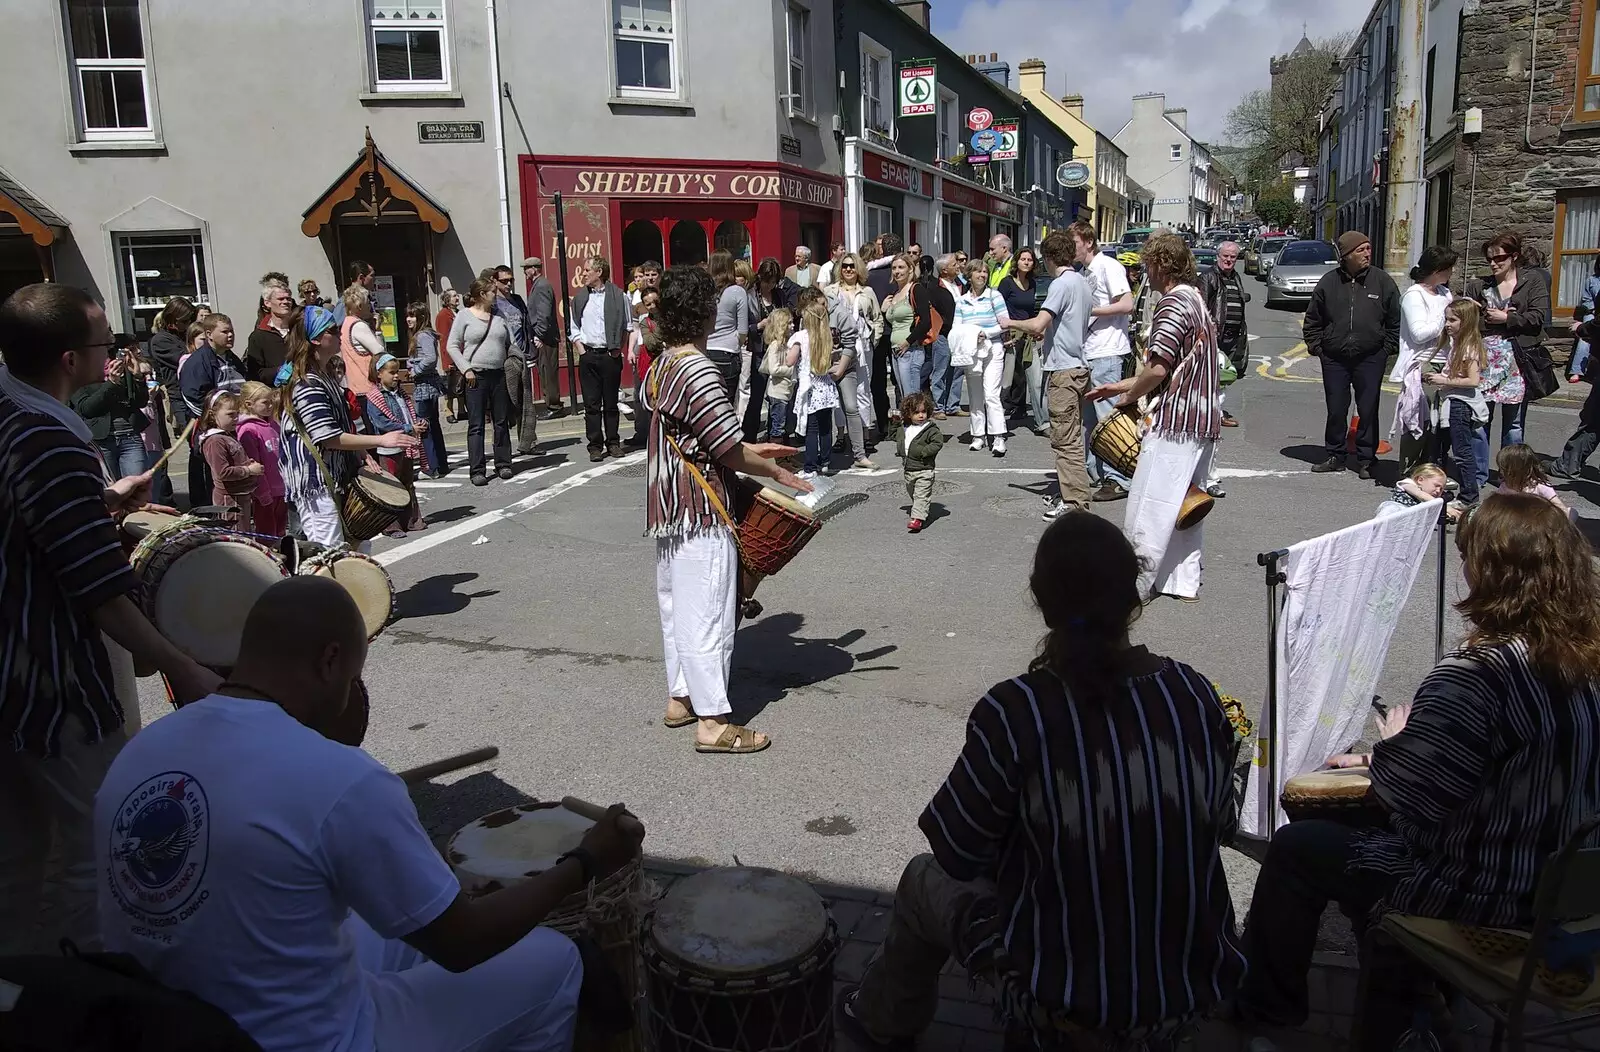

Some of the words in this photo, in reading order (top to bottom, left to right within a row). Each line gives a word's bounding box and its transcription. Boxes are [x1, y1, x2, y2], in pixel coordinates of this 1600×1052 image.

[903, 104, 934, 114] SPAR
[993, 151, 1017, 159] SPAR
[880, 160, 910, 185] SPAR
[574, 171, 716, 194] SHEEHY'S
[730, 175, 802, 200] CORNER
[807, 183, 833, 204] SHOP
